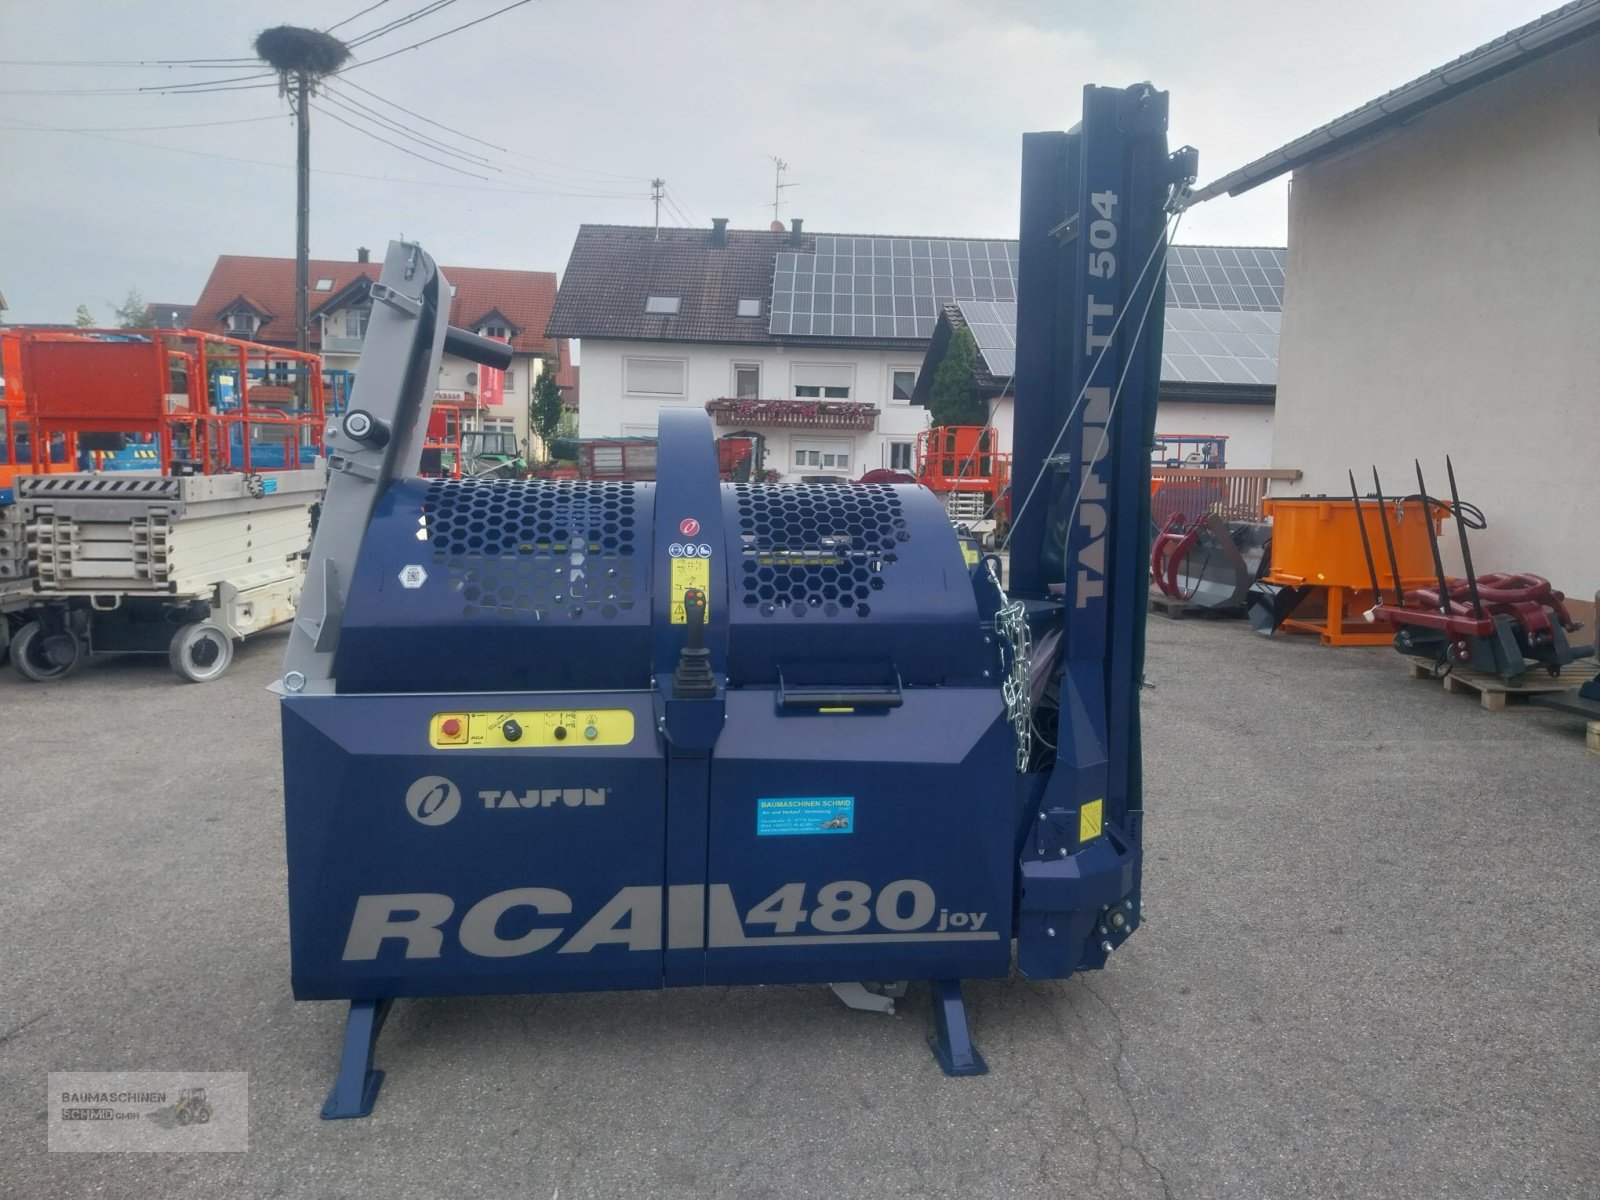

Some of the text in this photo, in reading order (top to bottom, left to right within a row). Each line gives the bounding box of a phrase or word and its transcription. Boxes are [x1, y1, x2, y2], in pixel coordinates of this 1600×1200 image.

[1076, 190, 1119, 609] TAJFUN TT 504
[478, 788, 606, 809] TAJFUN
[761, 799, 851, 808] BAUMASCHINEN SCHMID
[745, 879, 936, 933] 480
[937, 908, 988, 931] joy
